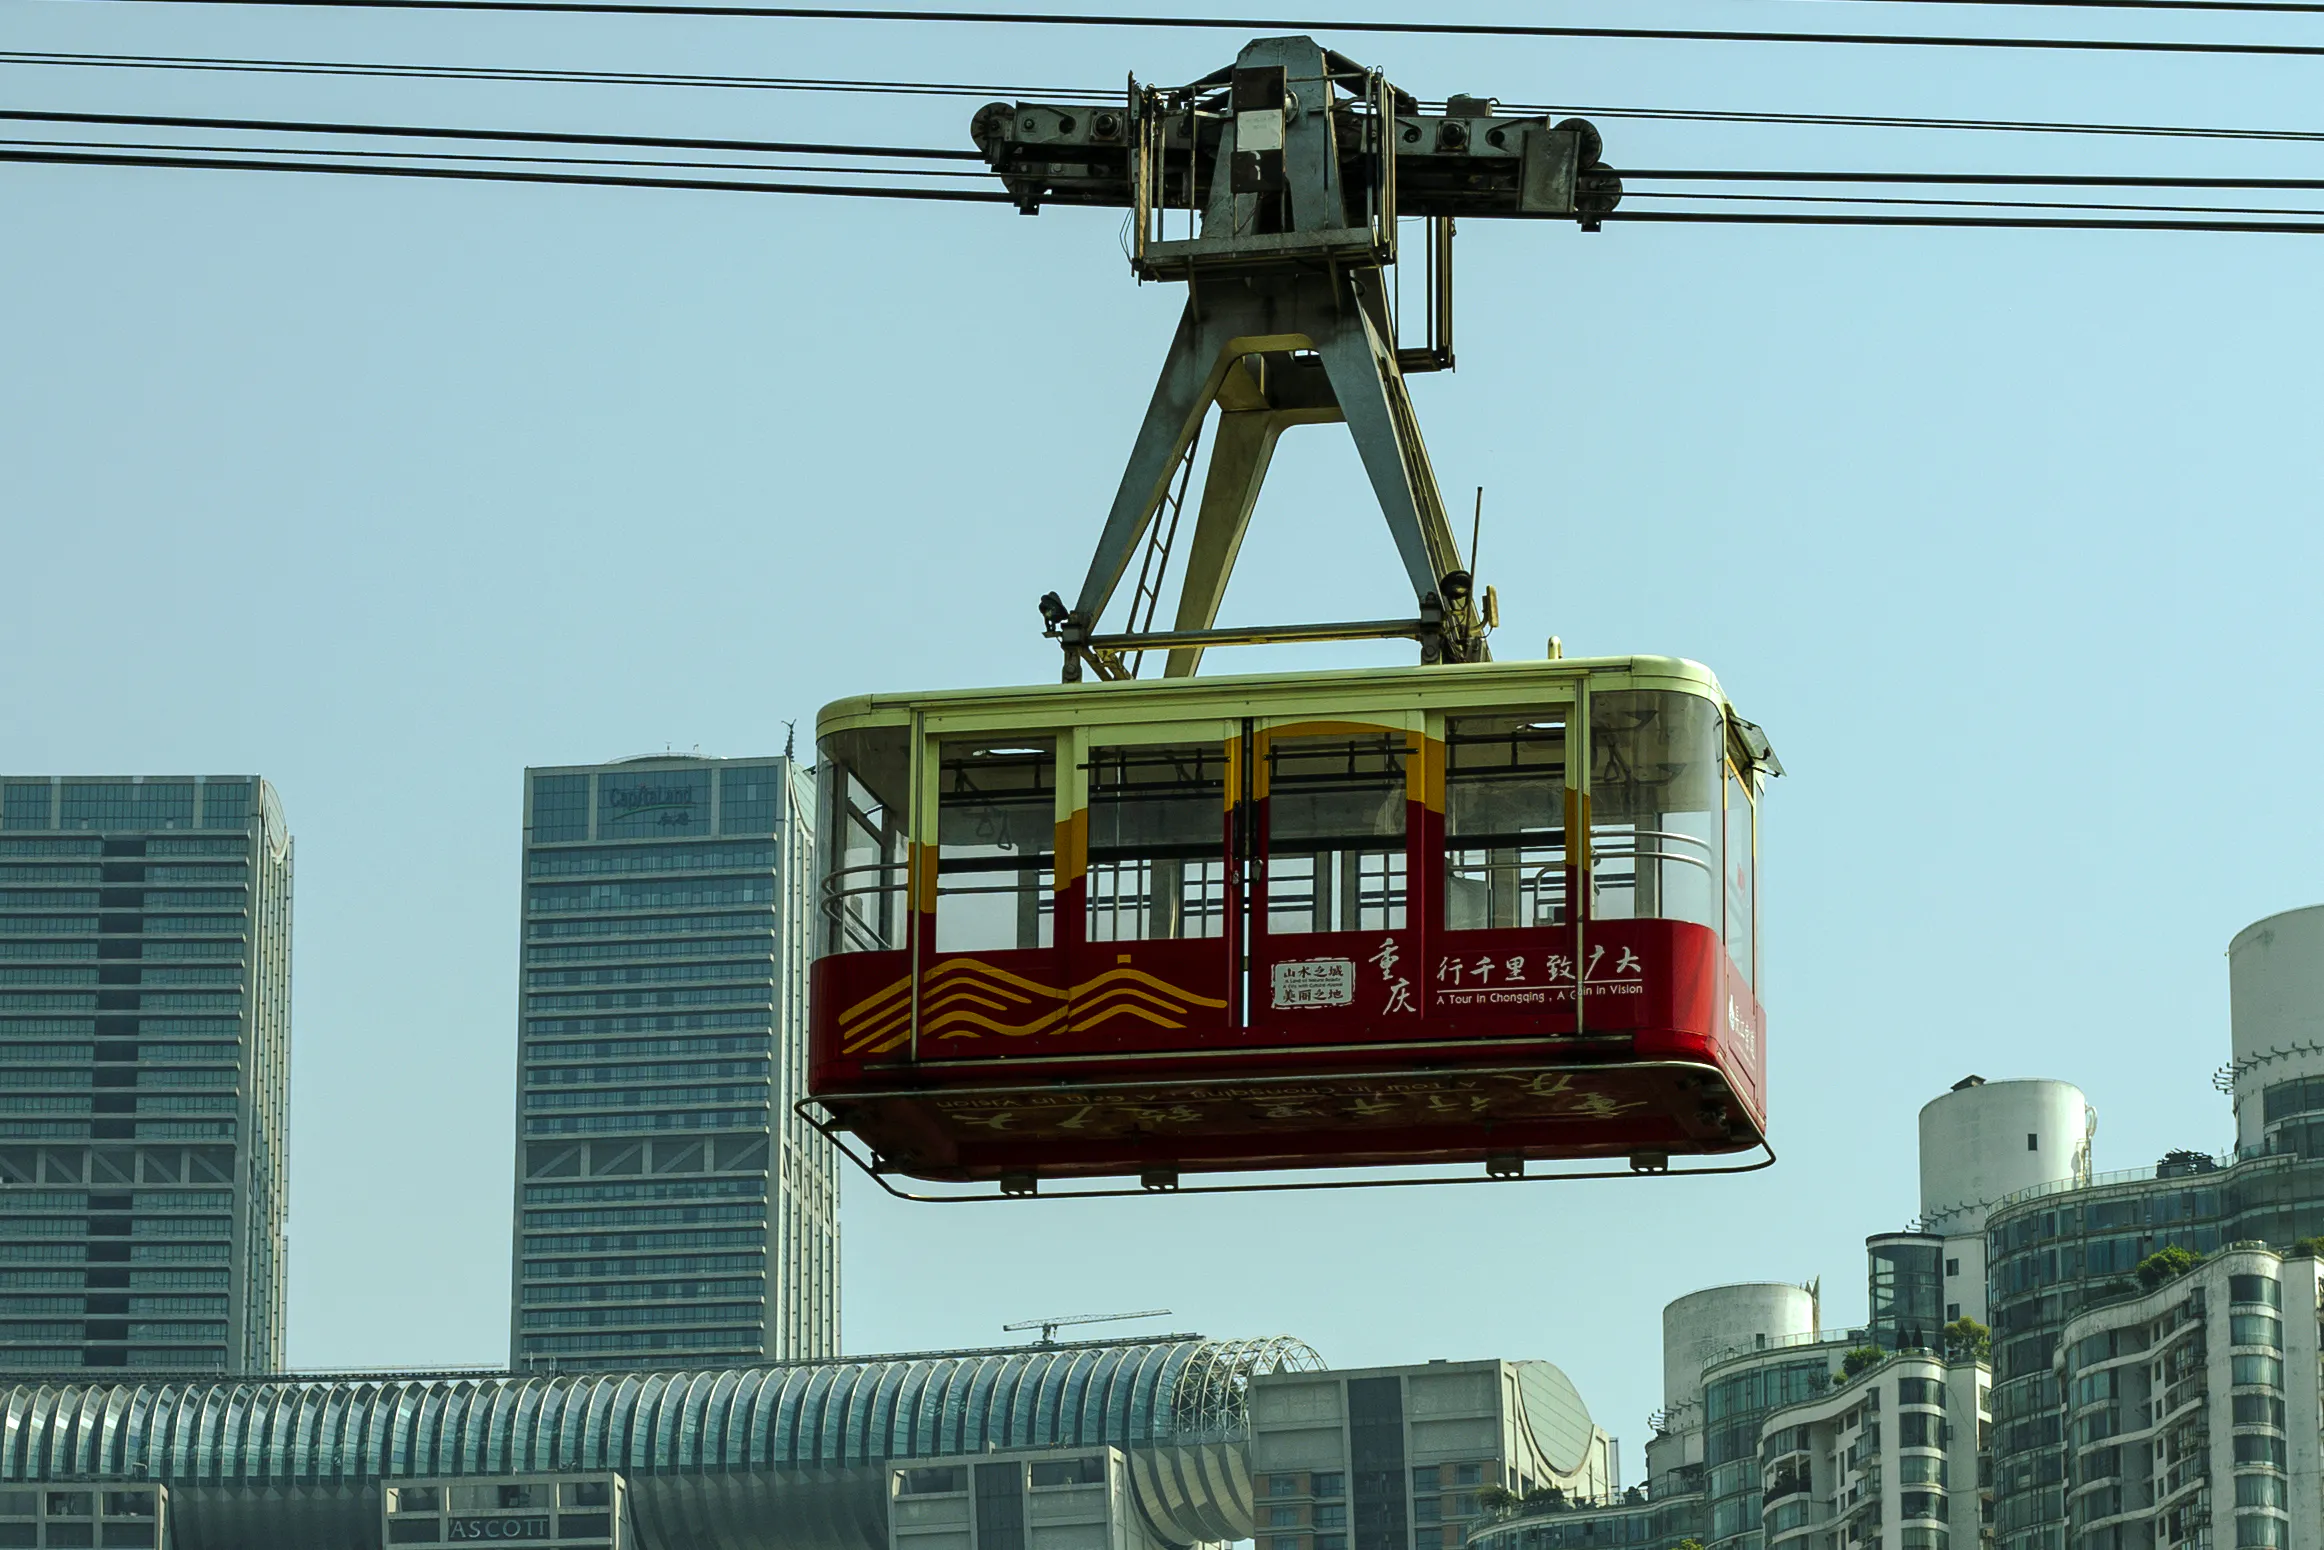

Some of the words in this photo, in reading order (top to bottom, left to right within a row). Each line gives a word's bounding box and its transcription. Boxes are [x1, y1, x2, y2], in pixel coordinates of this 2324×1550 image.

[1283, 965, 1344, 978] 山水之城
[1368, 937, 1417, 1016] 重庆
[1283, 989, 1344, 1003] 美丽之地
[1436, 995, 1444, 1005] A
[1449, 995, 1472, 1004] Tour
[1557, 991, 1565, 1000] A
[1596, 985, 1606, 995] in
[1610, 984, 1643, 994] Vision
[450, 1519, 549, 1538] ASCOTT
